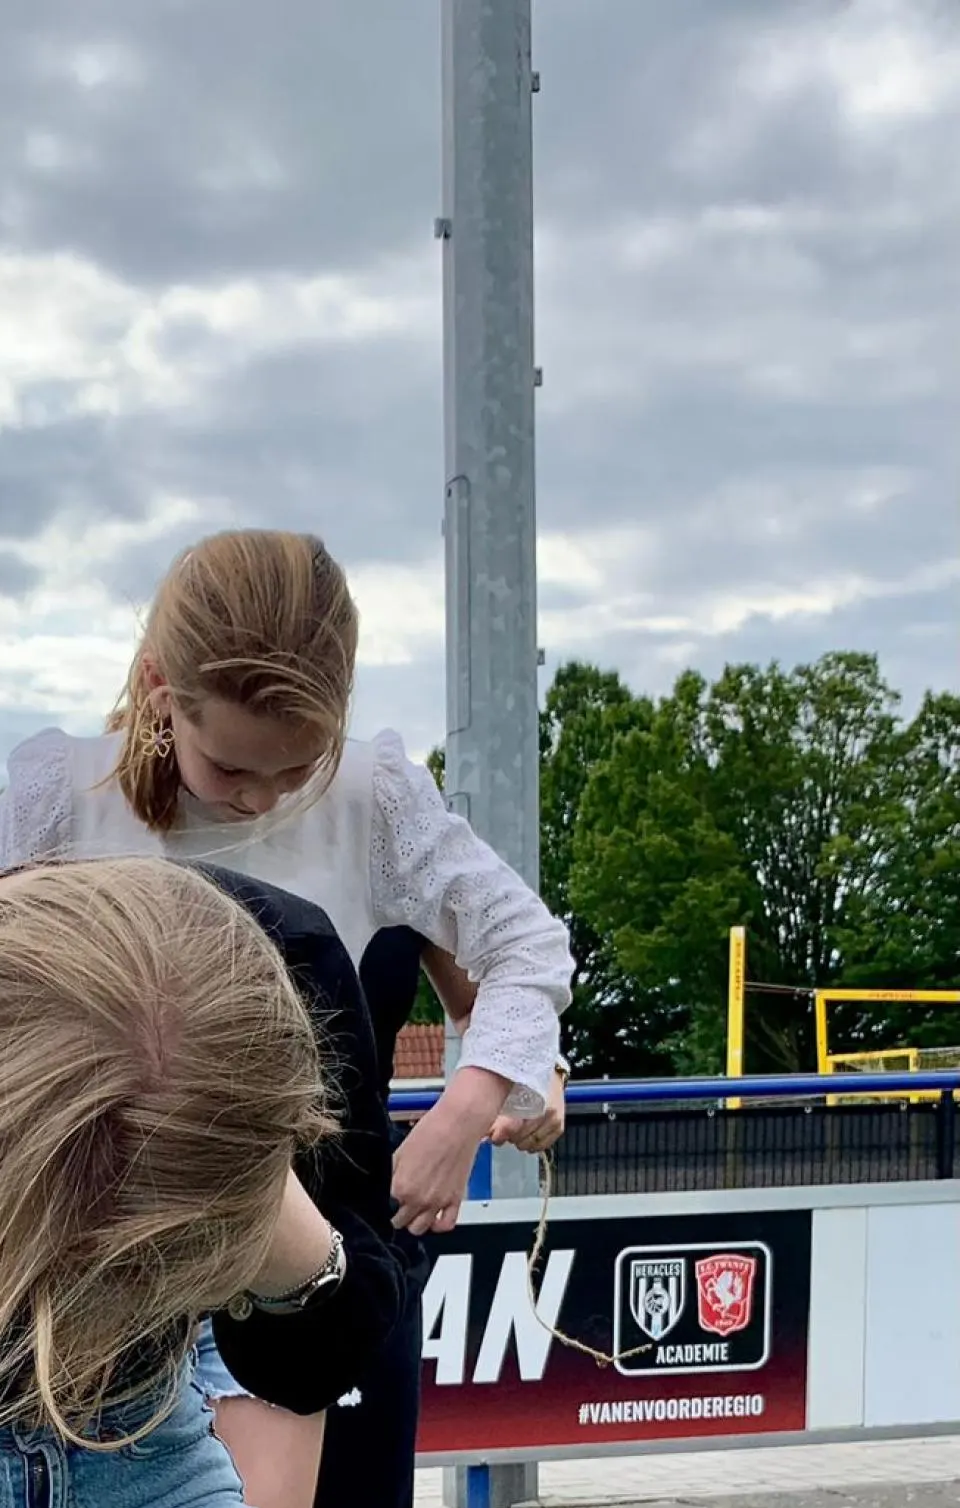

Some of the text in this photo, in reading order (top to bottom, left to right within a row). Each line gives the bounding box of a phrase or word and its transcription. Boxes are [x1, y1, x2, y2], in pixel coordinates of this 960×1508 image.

[635, 1263, 681, 1278] HERACLES
[655, 1342, 730, 1365] ACADEMIE
[577, 1394, 765, 1426] #VANENVOORDEREGIO
